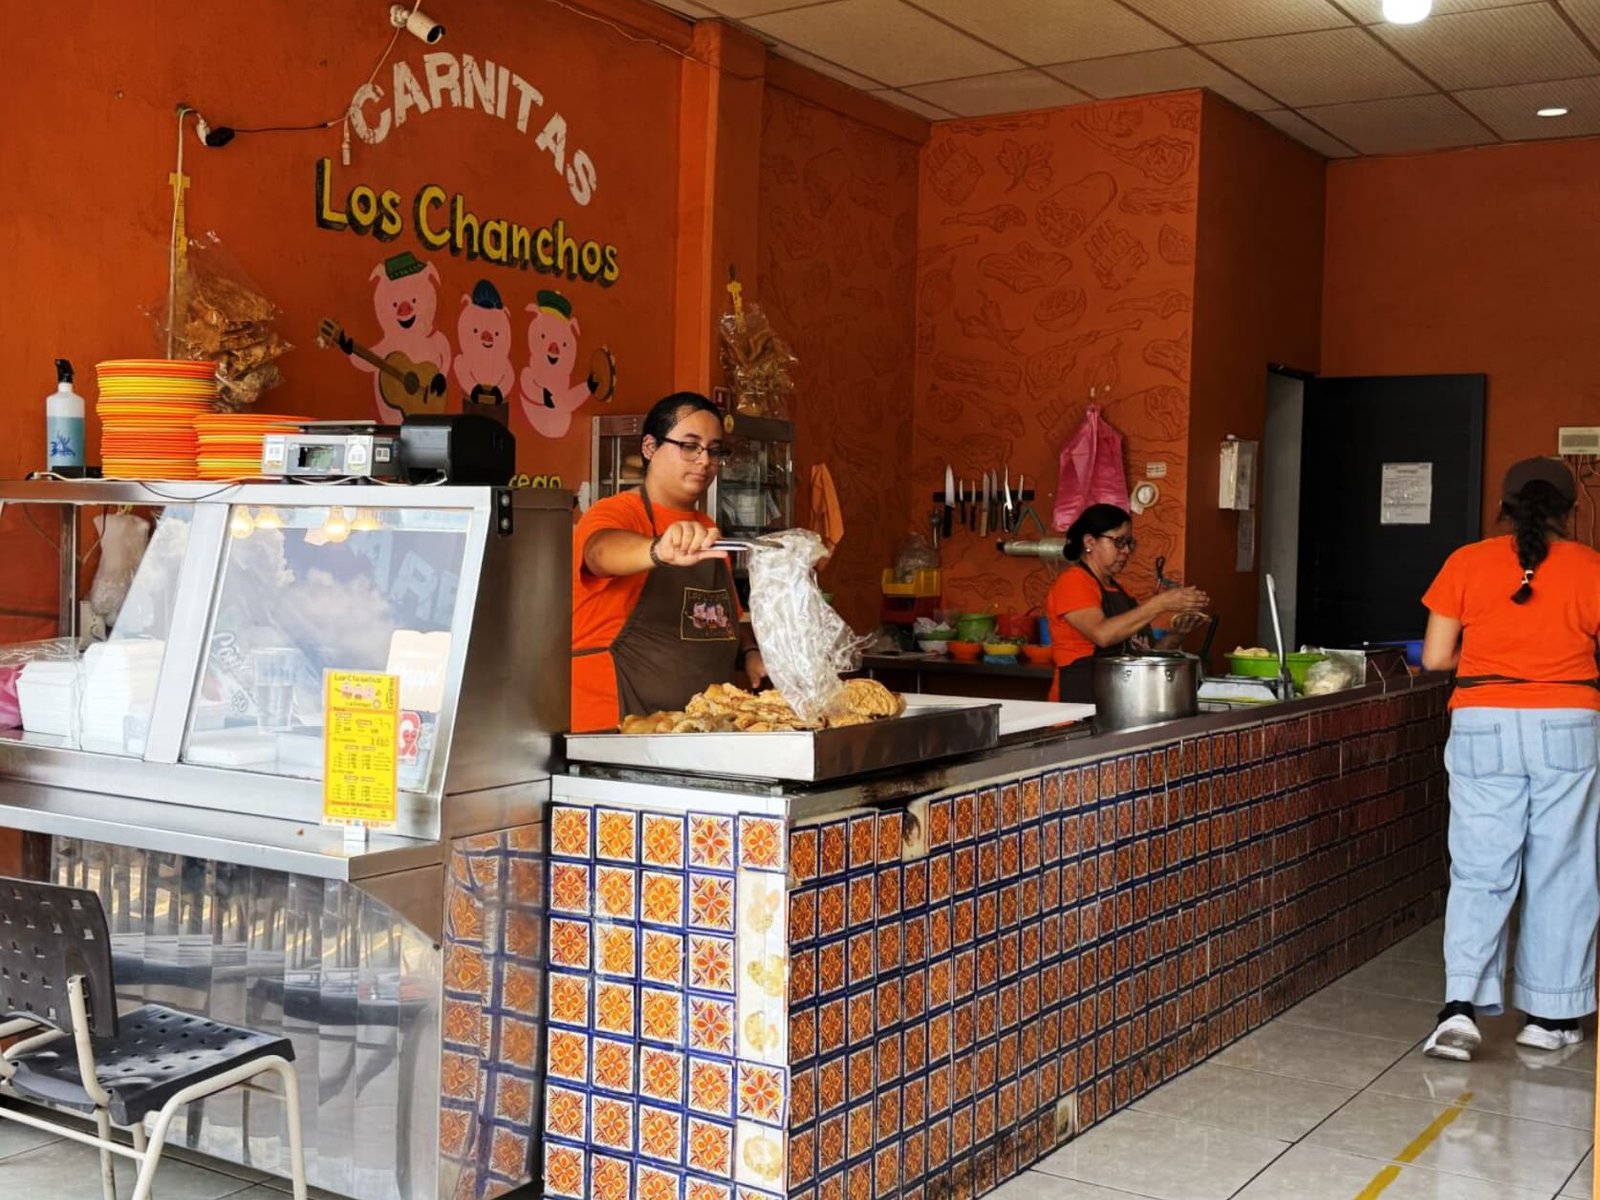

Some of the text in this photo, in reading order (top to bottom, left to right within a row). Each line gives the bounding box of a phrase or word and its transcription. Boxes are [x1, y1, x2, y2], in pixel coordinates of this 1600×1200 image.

[350, 52, 597, 206] CARNITAS
[316, 158, 620, 288] Los Chanchos
